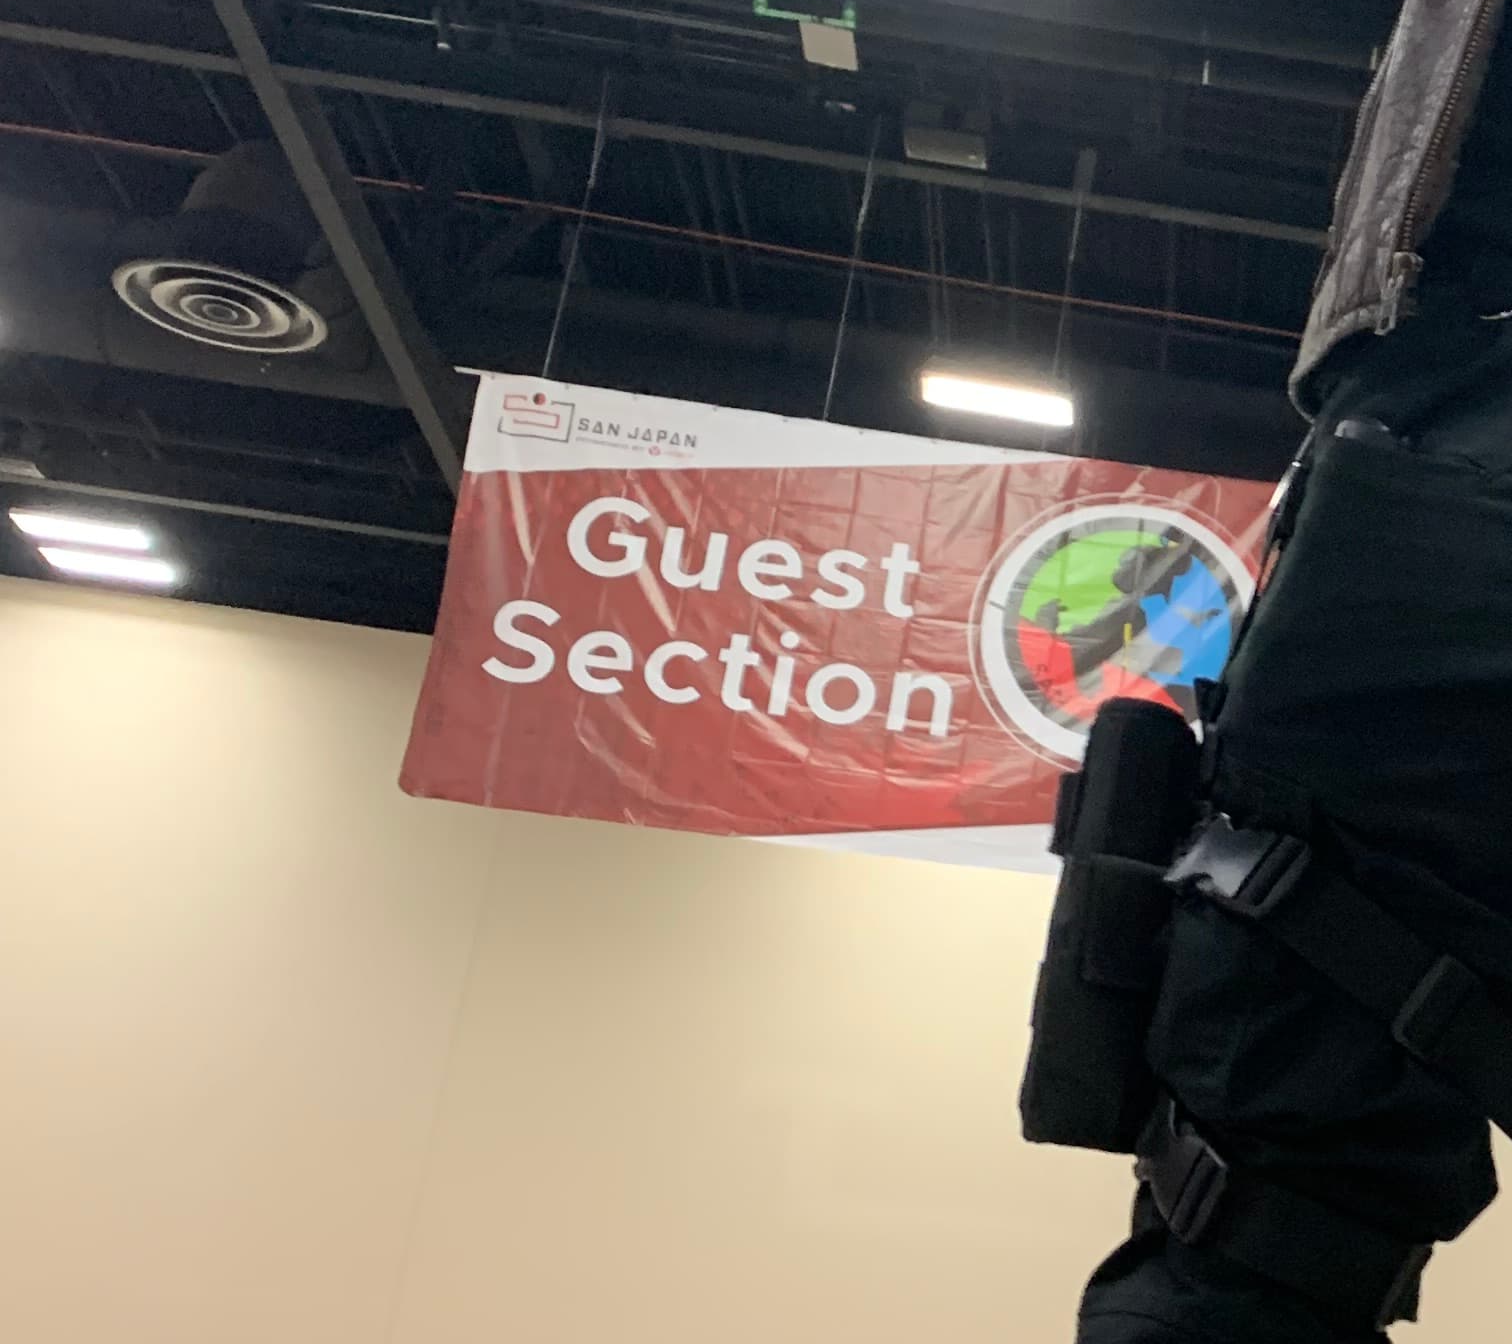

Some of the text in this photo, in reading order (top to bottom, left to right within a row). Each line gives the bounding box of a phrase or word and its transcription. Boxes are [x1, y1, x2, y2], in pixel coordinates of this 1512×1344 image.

[577, 417, 620, 437] SAN
[627, 426, 698, 448] JAPAN
[566, 497, 919, 619] Guest
[481, 600, 953, 737] Section
